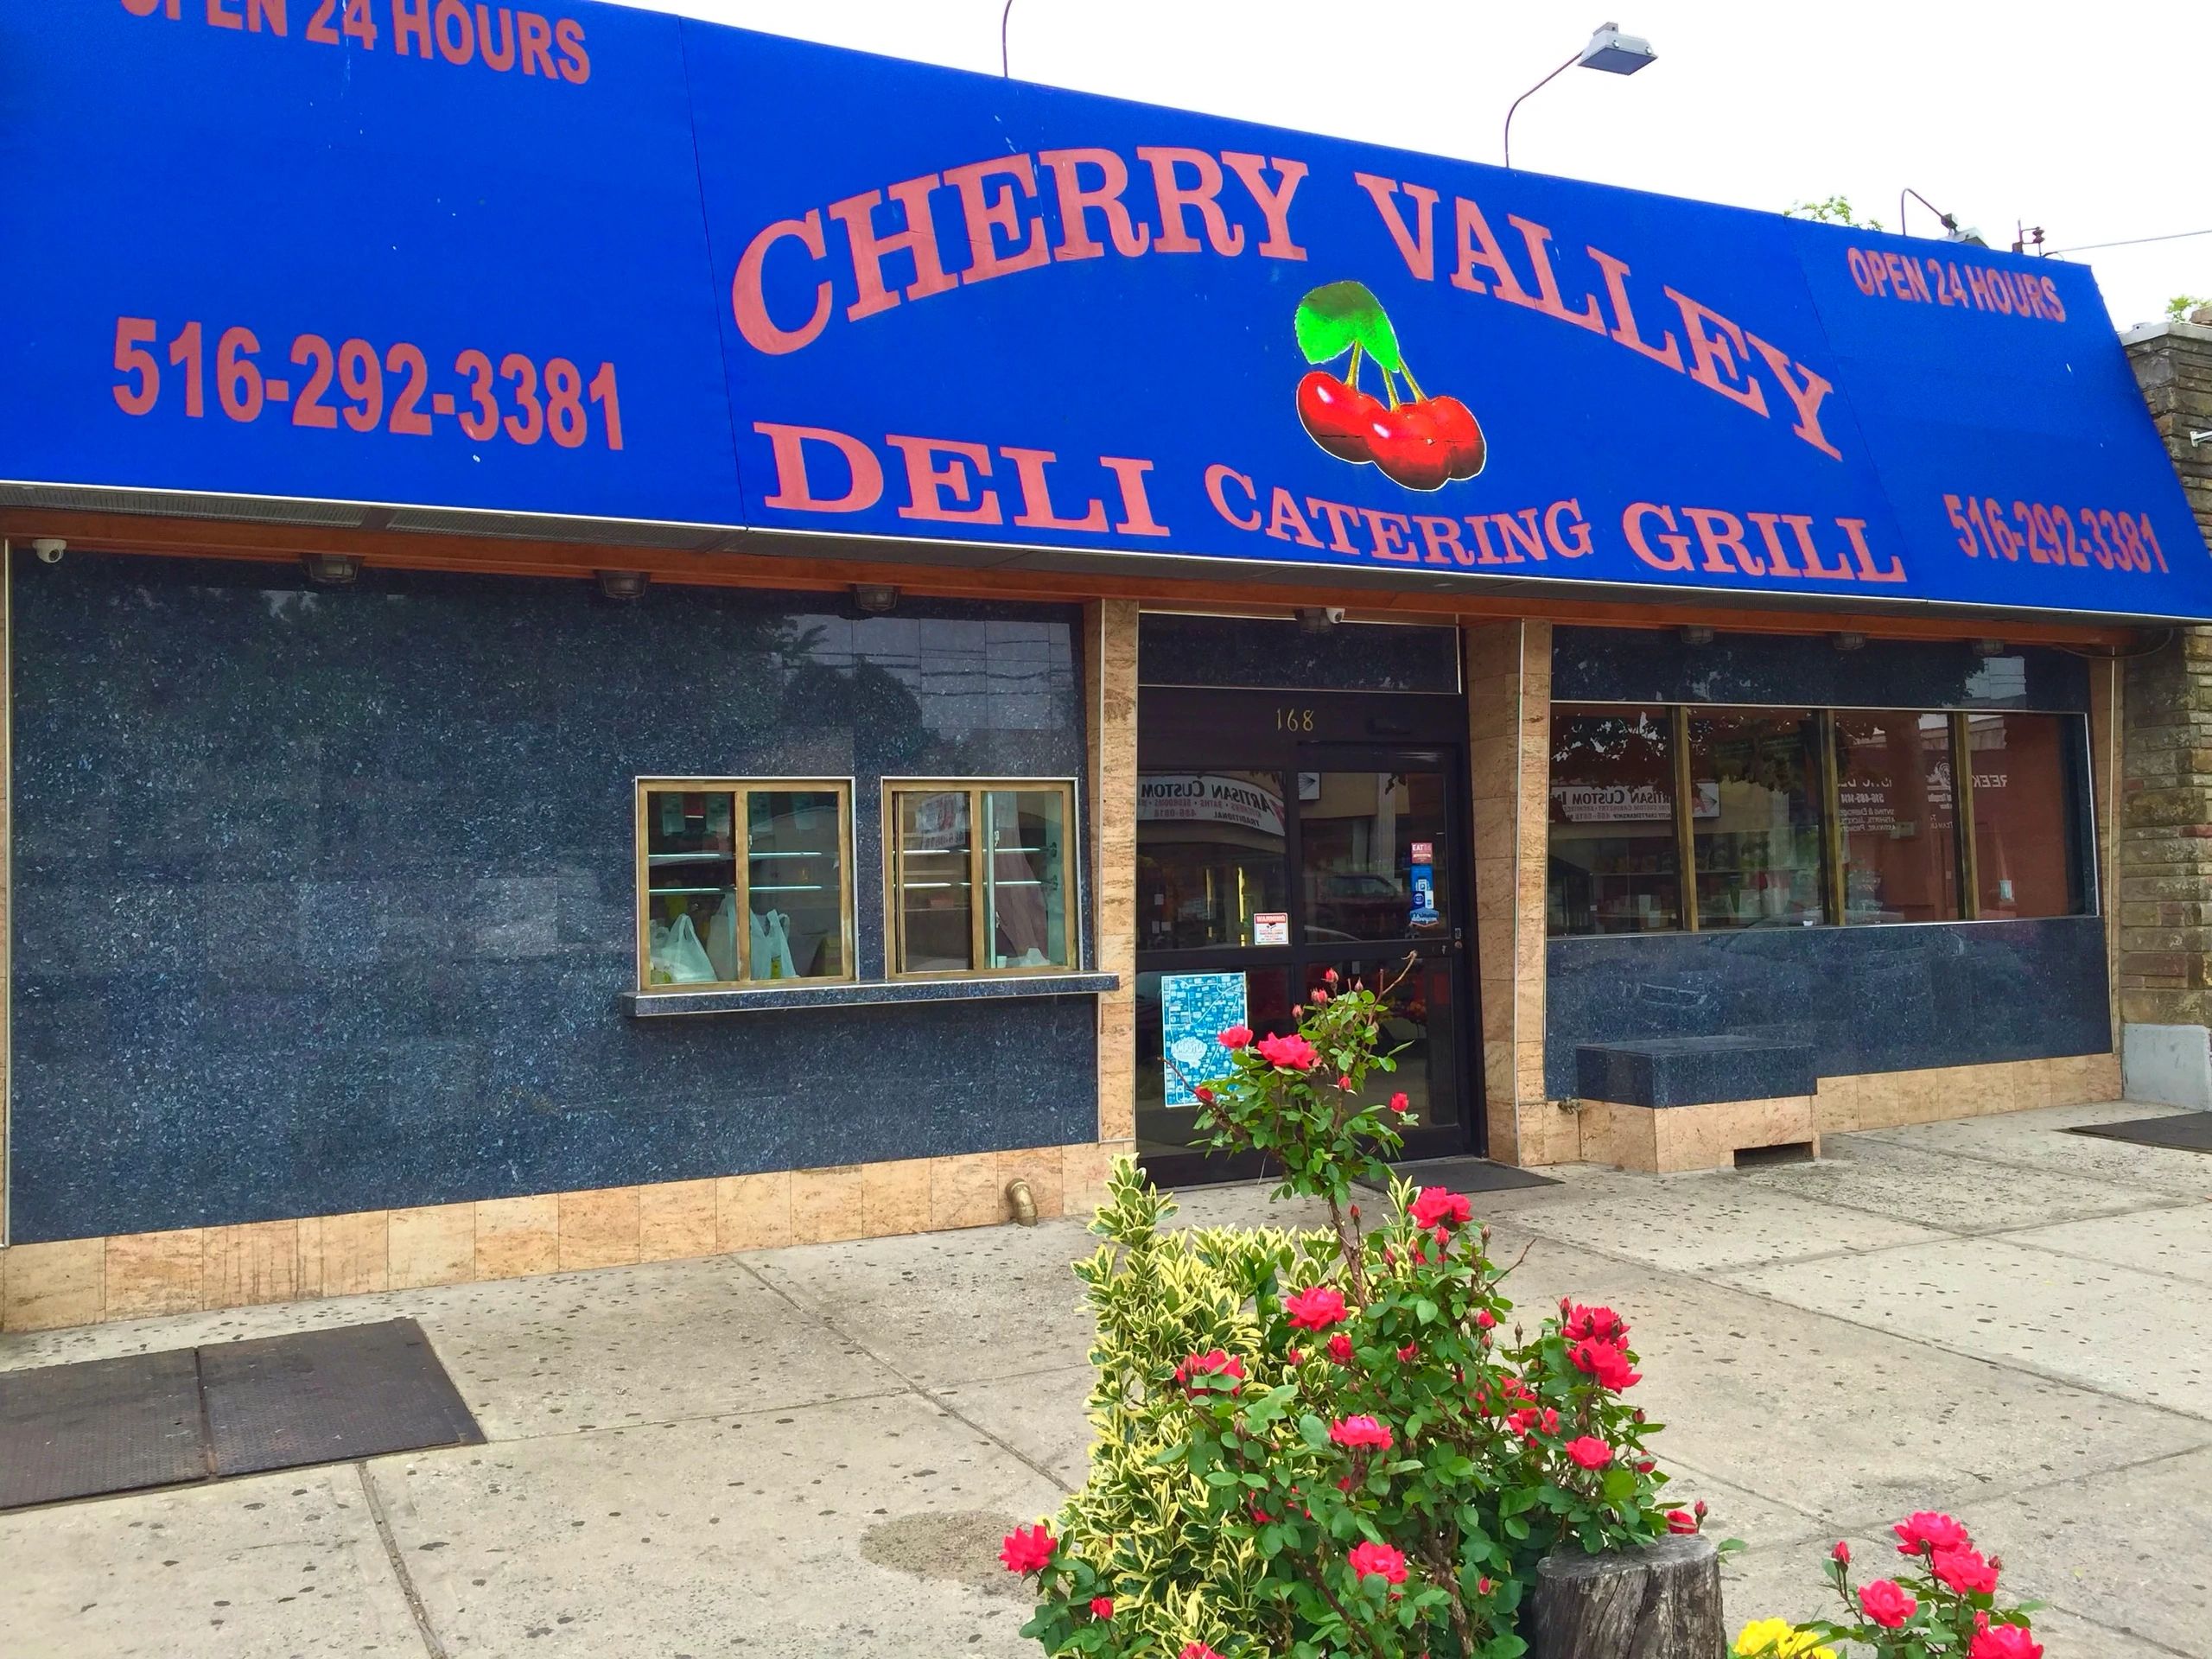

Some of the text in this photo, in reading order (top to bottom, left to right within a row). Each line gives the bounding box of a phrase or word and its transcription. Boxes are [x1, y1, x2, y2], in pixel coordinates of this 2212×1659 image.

[305, 0, 378, 50] 24
[391, 0, 591, 85] HOURS
[732, 146, 1842, 461] CHERRY VALLEY
[1847, 246, 2066, 322] OPEN 24 HOURS
[112, 316, 624, 451] 516-292-3381
[753, 421, 1907, 583] DELI CATERING GRILL
[1942, 493, 2170, 575] 516-292-3381
[1276, 707, 1315, 733] 168
